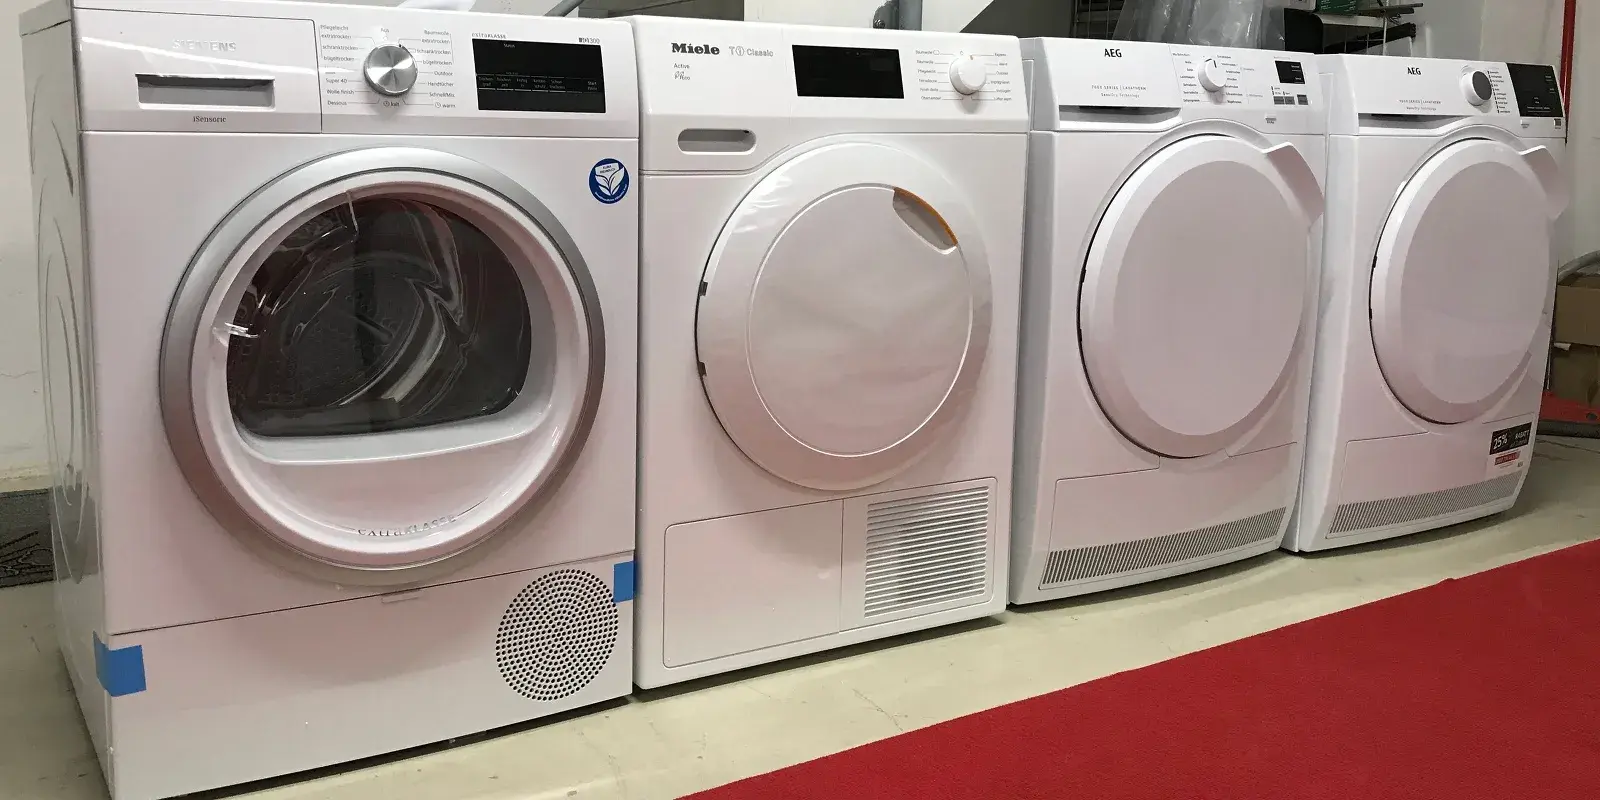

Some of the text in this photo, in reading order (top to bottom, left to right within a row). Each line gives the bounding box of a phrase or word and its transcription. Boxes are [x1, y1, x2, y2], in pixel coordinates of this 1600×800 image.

[671, 42, 720, 55] Miele
[746, 48, 774, 58] Classic
[1104, 48, 1122, 58] AEG
[1407, 66, 1422, 76] AEG
[192, 115, 227, 123] iSensoric
[1493, 433, 1508, 449] 25%
